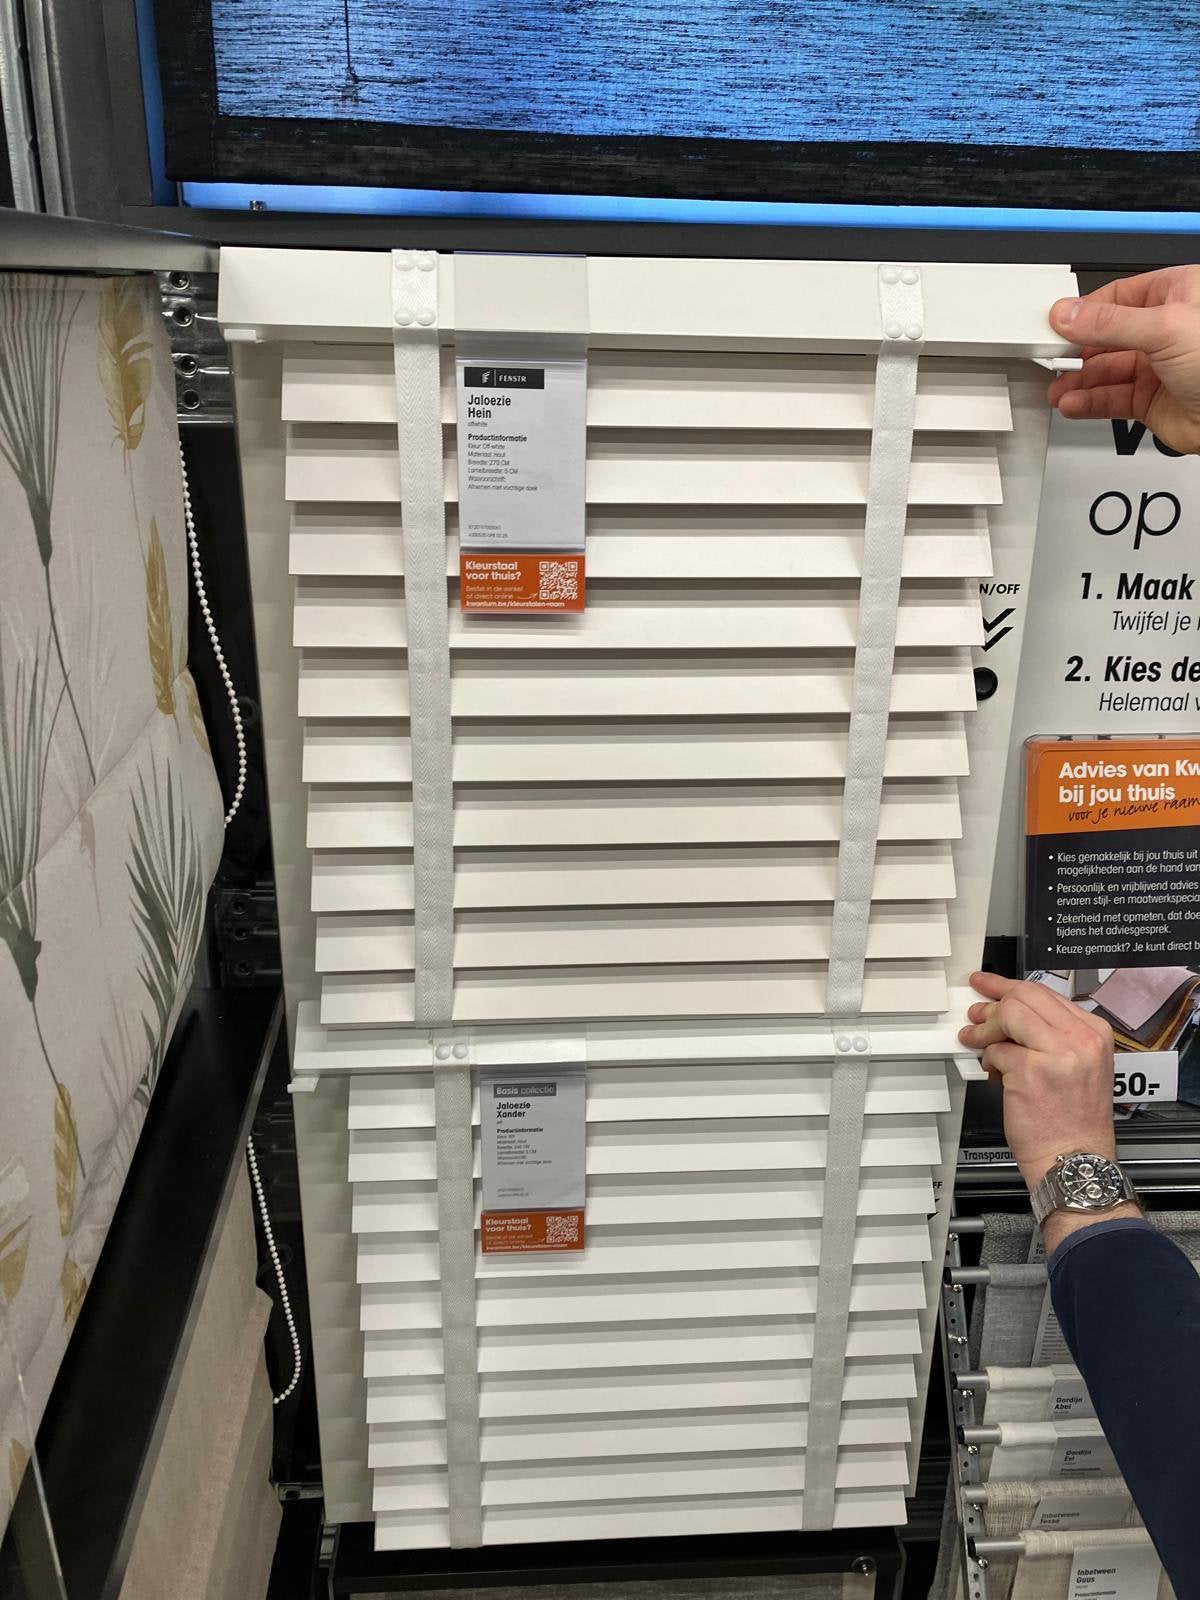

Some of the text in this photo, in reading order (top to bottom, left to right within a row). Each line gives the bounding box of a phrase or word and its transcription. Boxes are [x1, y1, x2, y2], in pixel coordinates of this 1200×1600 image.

[468, 395, 511, 406] Jaloezie
[468, 407, 492, 418] Hein
[468, 433, 527, 442] Productinformatie
[1089, 491, 1181, 550] op
[465, 561, 518, 570] Kleurstaal
[491, 571, 521, 580] thuis?
[979, 584, 1020, 595] N/OFF
[1080, 572, 1195, 600] 1. Maak
[1112, 611, 1169, 635] Twijfel
[1172, 612, 1191, 635] je
[1065, 655, 1200, 682] 2. Kies de
[1099, 692, 1189, 711] Helemaal
[1059, 761, 1127, 778] Advies
[1132, 763, 1169, 777] van
[1059, 783, 1175, 806] bij jou thuis
[1068, 810, 1092, 822] voor
[1092, 807, 1108, 824] je
[1114, 801, 1158, 817] nieuwe
[1057, 850, 1198, 864] Kies gemakkelijk bij jou thuis uit
[1057, 864, 1124, 876] mogelijkheden
[1126, 865, 1143, 873] aan
[1146, 864, 1158, 873] de
[1160, 863, 1182, 872] hand
[1057, 880, 1198, 894] Persoonlijk en vrijblijvend advies
[1057, 897, 1091, 906] ervaren
[1093, 895, 1111, 907] stijl-
[1113, 896, 1125, 904] en
[1057, 913, 1101, 924] Zekerheid
[1103, 913, 1121, 922] met
[1123, 912, 1166, 924] opmeten,
[1167, 911, 1182, 921] dat
[1057, 924, 1171, 938] tijdens het adviesgesprek.
[1057, 944, 1083, 954] Keuze
[1085, 943, 1130, 955] gemaakt?
[1133, 943, 1143, 952] Je
[1145, 942, 1165, 951] kunt
[1167, 941, 1192, 950] direct
[496, 1085, 554, 1095] Basis collectie
[496, 1101, 531, 1110] Jaloezie
[486, 1217, 529, 1225] Kleurstaal
[507, 1224, 532, 1232] thuis?
